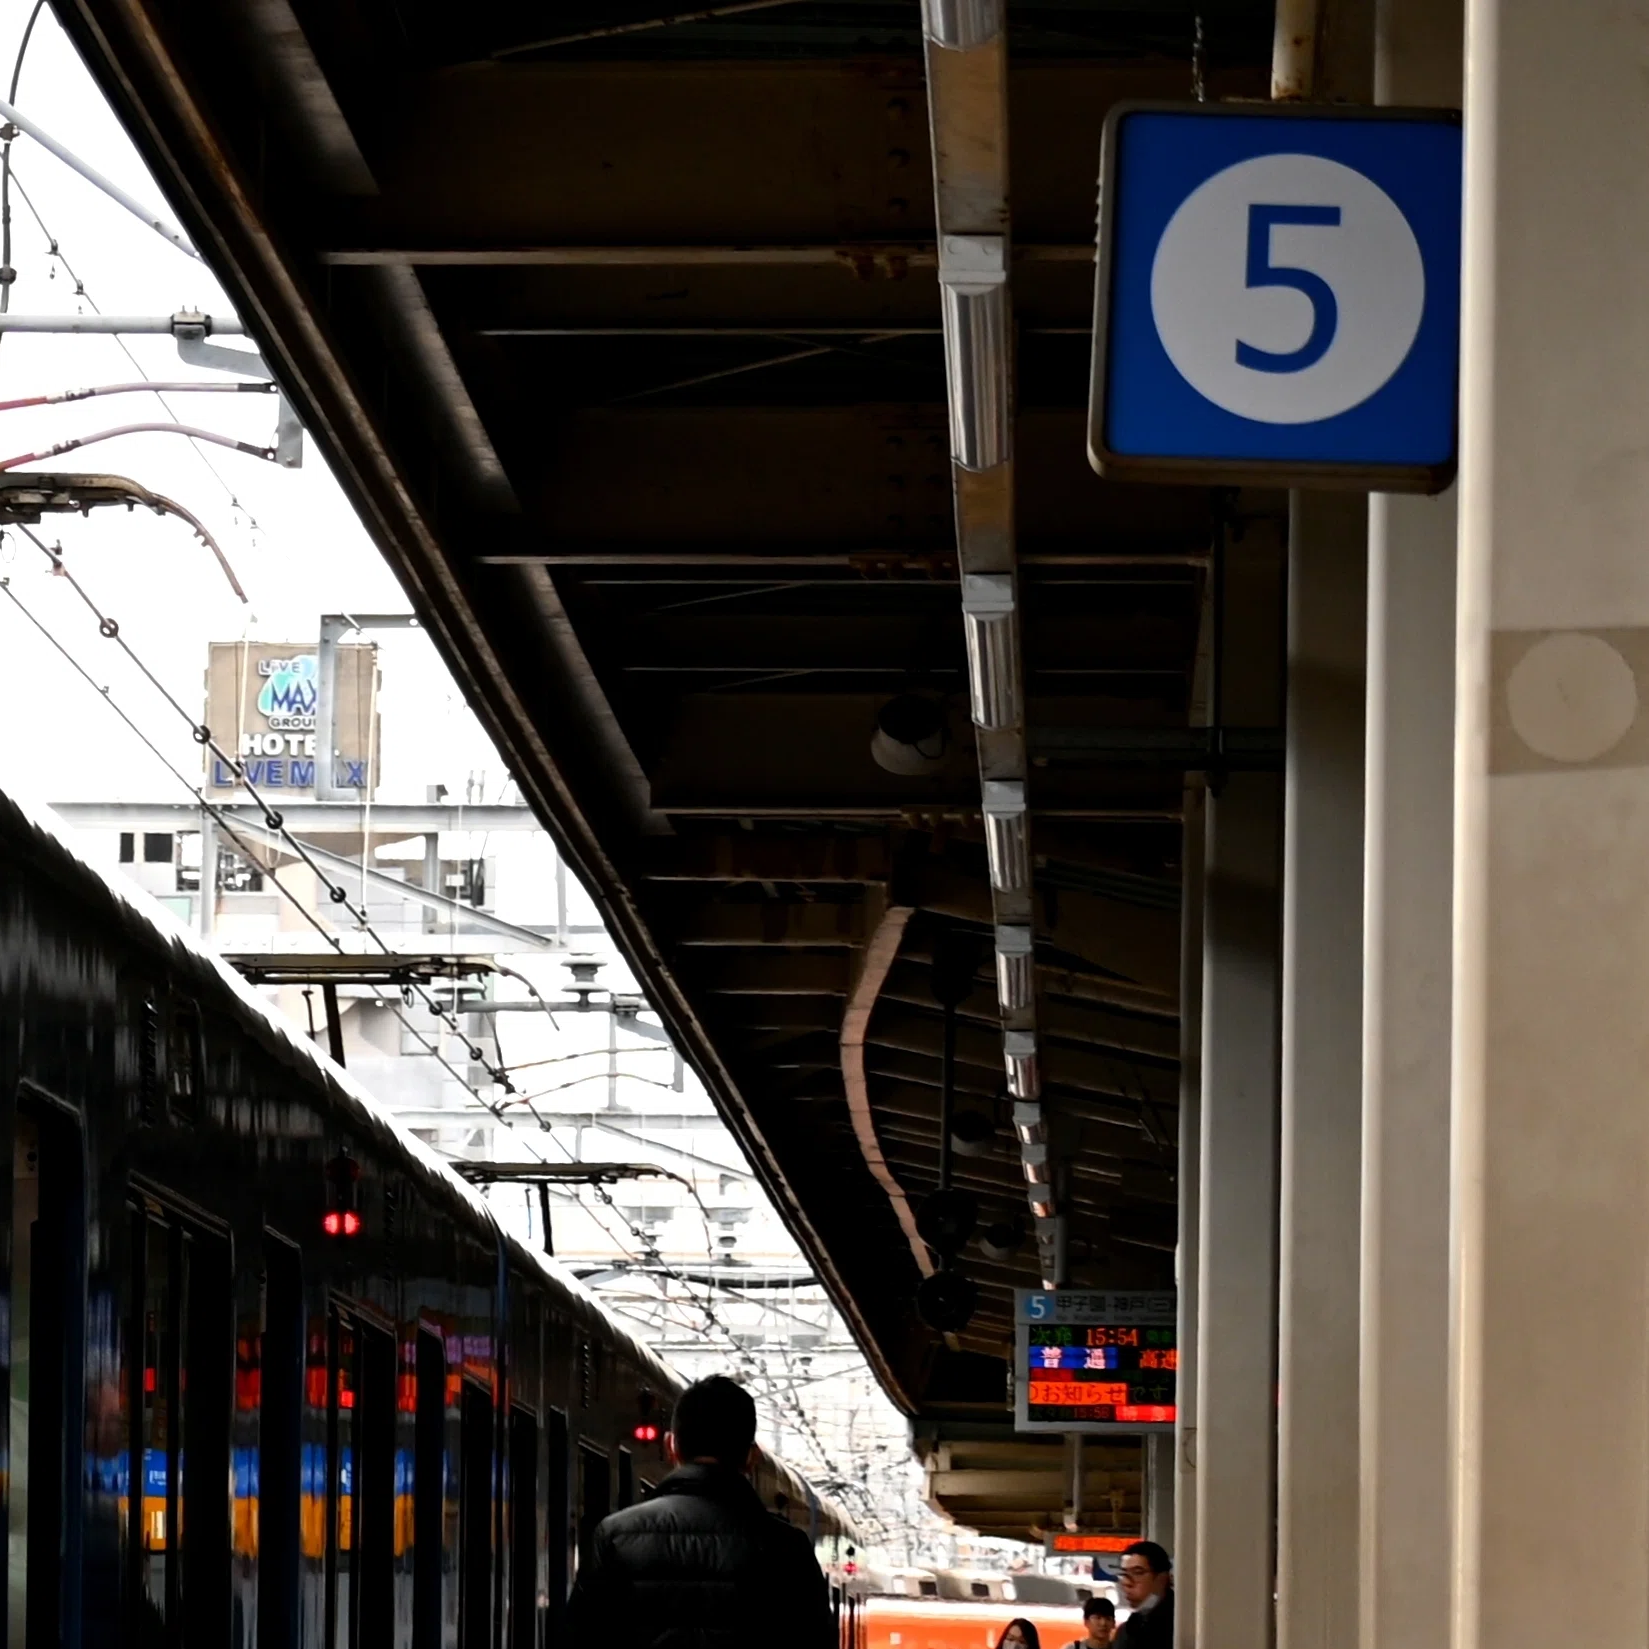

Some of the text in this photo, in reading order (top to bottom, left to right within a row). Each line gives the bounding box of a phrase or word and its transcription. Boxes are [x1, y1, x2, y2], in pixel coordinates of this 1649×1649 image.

[1234, 203, 1342, 374] 5
[269, 717, 317, 728] GROU
[1030, 1295, 1047, 1320] 5
[1086, 1327, 1141, 1347] 15:54
